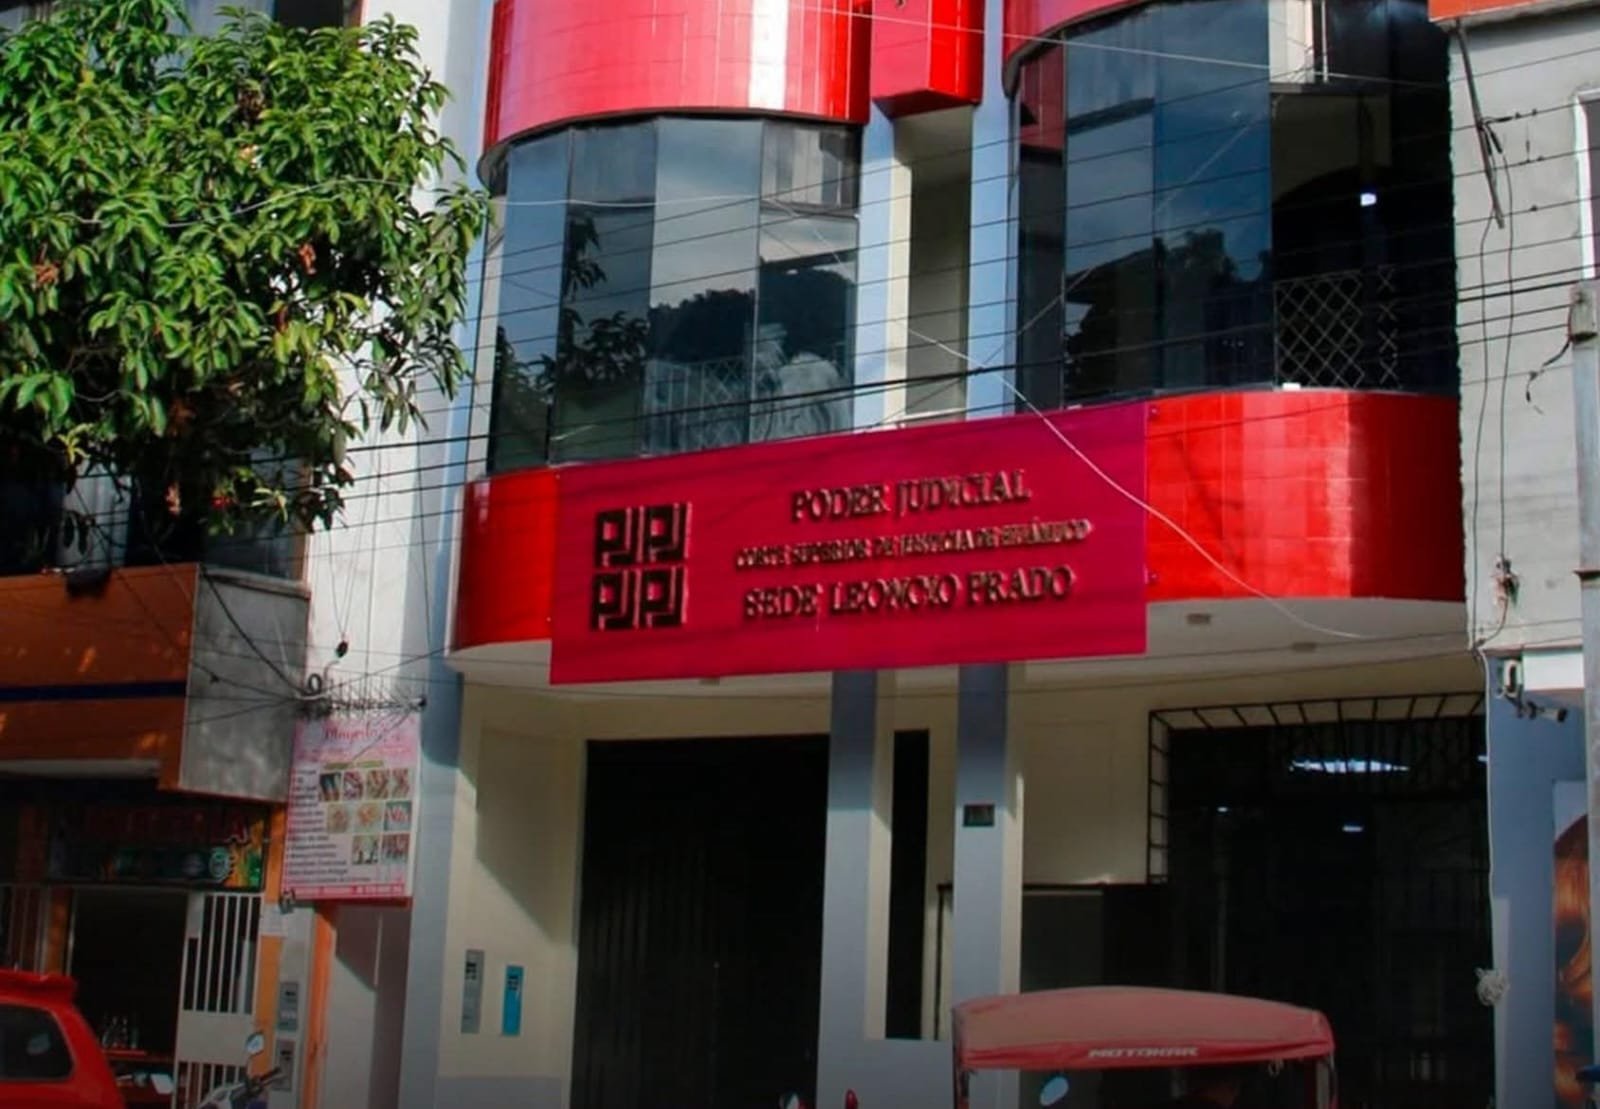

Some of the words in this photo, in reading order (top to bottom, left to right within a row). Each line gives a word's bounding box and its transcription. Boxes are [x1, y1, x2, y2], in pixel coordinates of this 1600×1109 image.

[792, 483, 891, 524] PODER
[897, 468, 1033, 516] JUDICIAL
[744, 583, 824, 619] SEDE
[828, 571, 962, 613] LEONCIO
[967, 563, 1077, 605] PRADO
